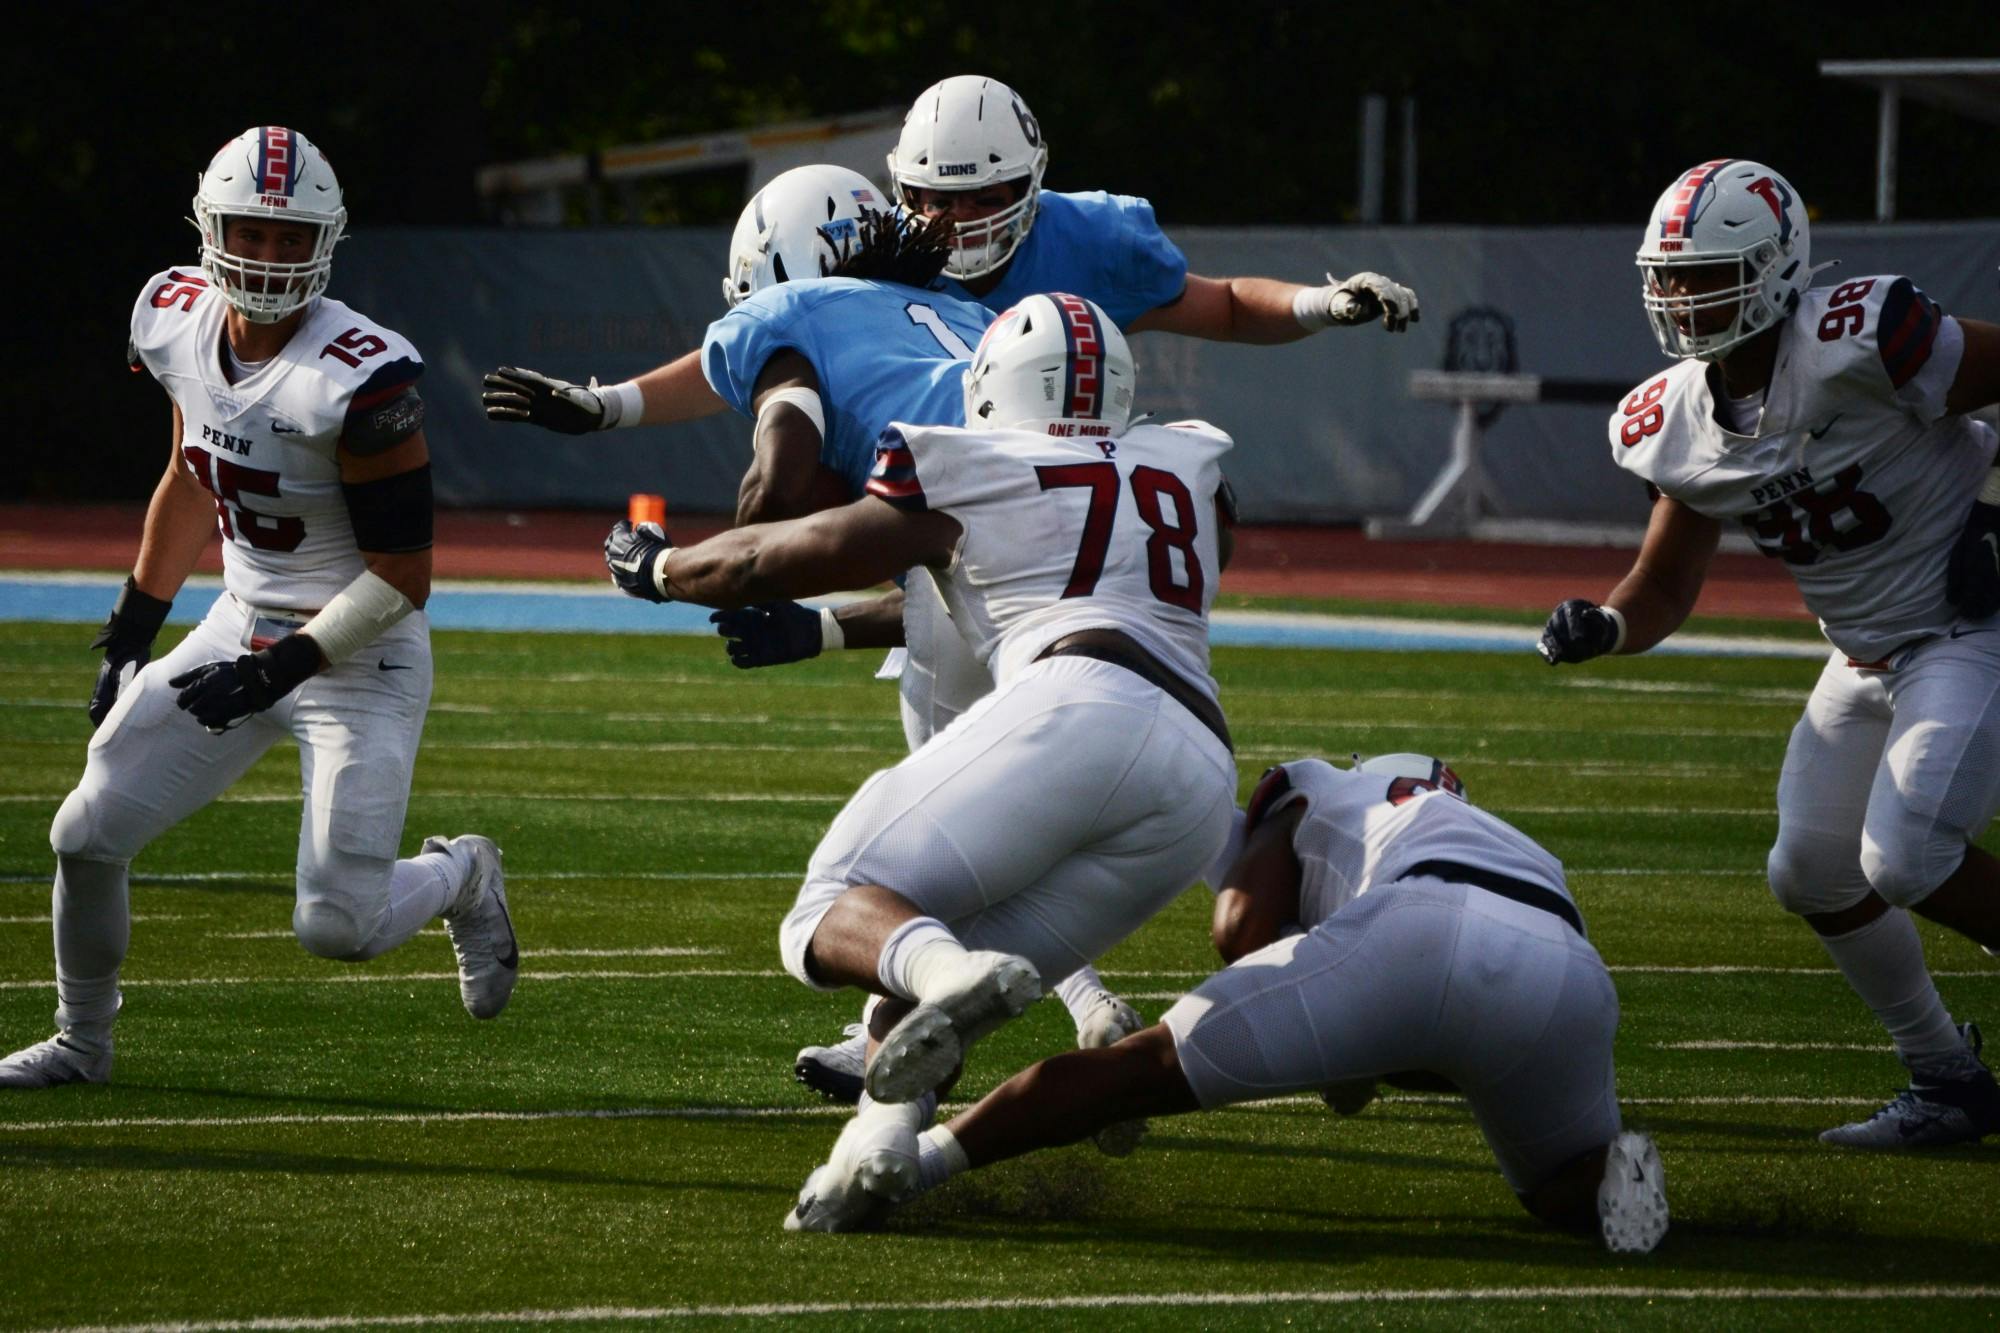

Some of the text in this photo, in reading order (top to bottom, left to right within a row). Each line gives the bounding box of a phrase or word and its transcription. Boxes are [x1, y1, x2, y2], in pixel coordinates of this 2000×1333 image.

[1011, 99, 1039, 148] 6
[938, 162, 978, 178] LIONS
[260, 195, 289, 209] PENN
[1659, 240, 1684, 253] PENN
[149, 269, 210, 313] 15
[1816, 277, 1878, 342] 98
[318, 326, 389, 370] 15
[903, 301, 976, 360] 1
[1047, 422, 1113, 438] ONE MORE
[1620, 376, 1669, 449] 98
[202, 423, 254, 457] PENN
[1095, 439, 1117, 460] P
[183, 446, 308, 553] 15
[1749, 465, 1816, 506] PENN
[1033, 460, 1205, 615] 78
